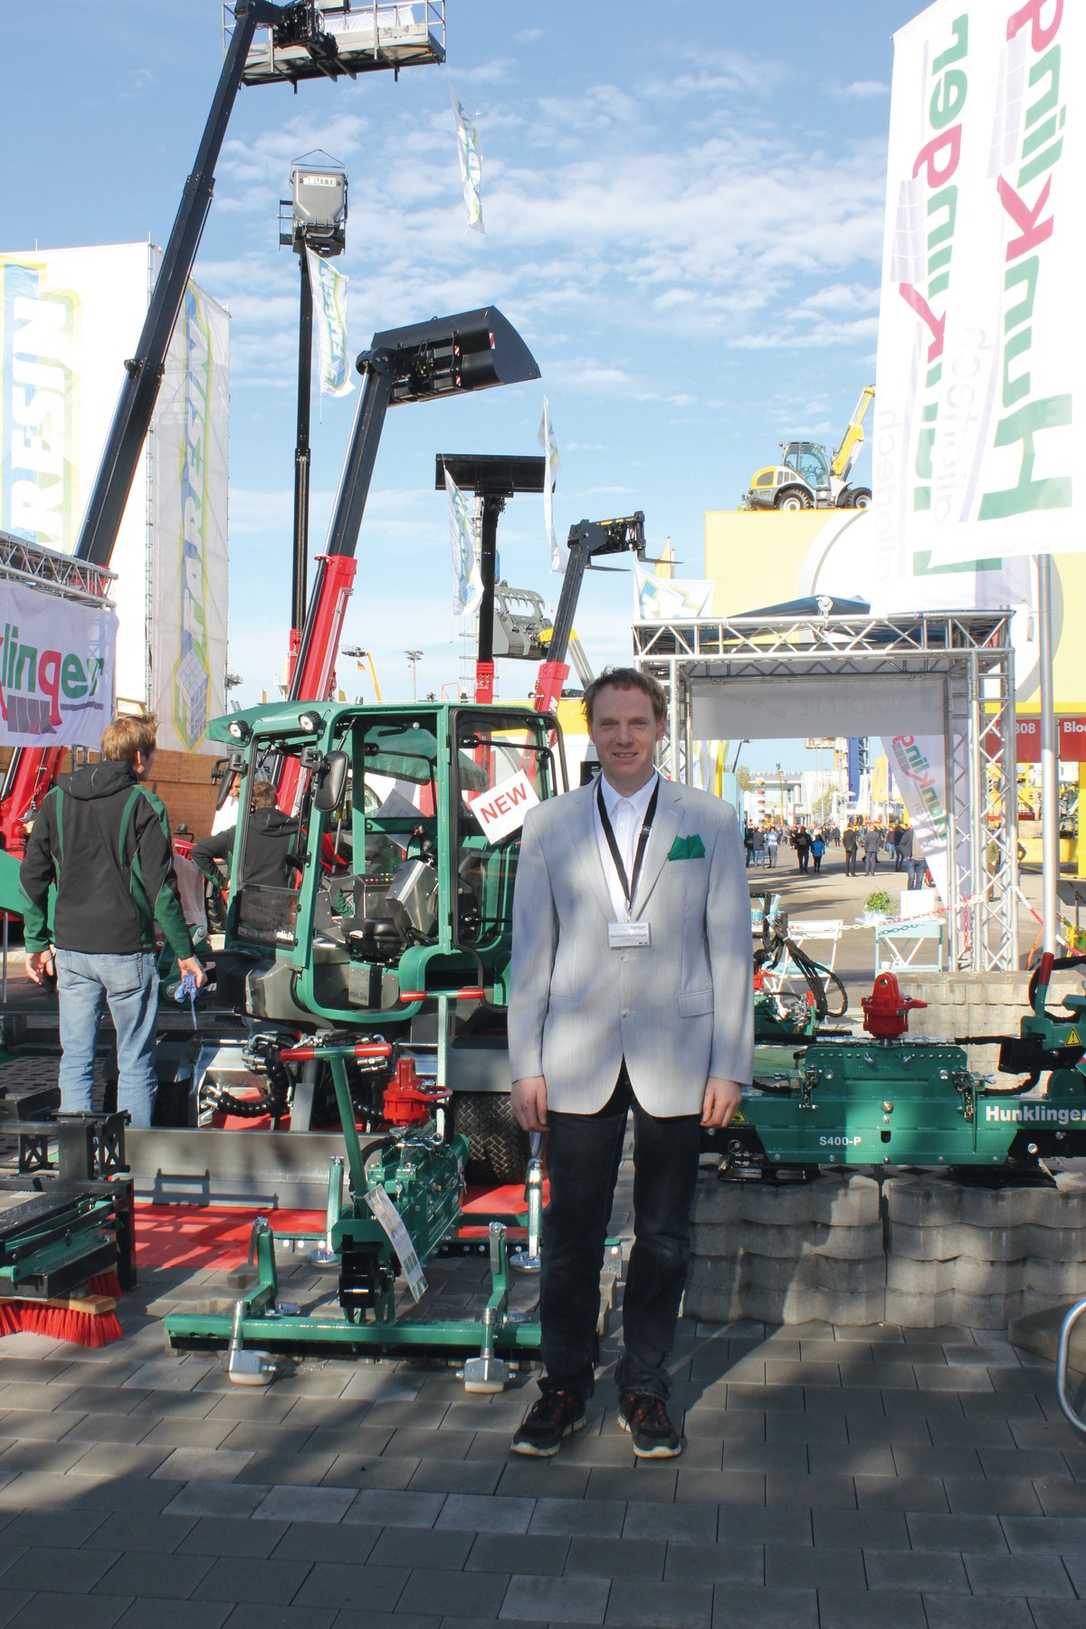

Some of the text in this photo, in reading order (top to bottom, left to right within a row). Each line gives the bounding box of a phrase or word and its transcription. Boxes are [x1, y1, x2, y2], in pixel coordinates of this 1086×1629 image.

[11, 297, 66, 552] RESIN
[0, 623, 104, 727] linger
[480, 782, 527, 824] NEW
[819, 1136, 862, 1146] S400-P
